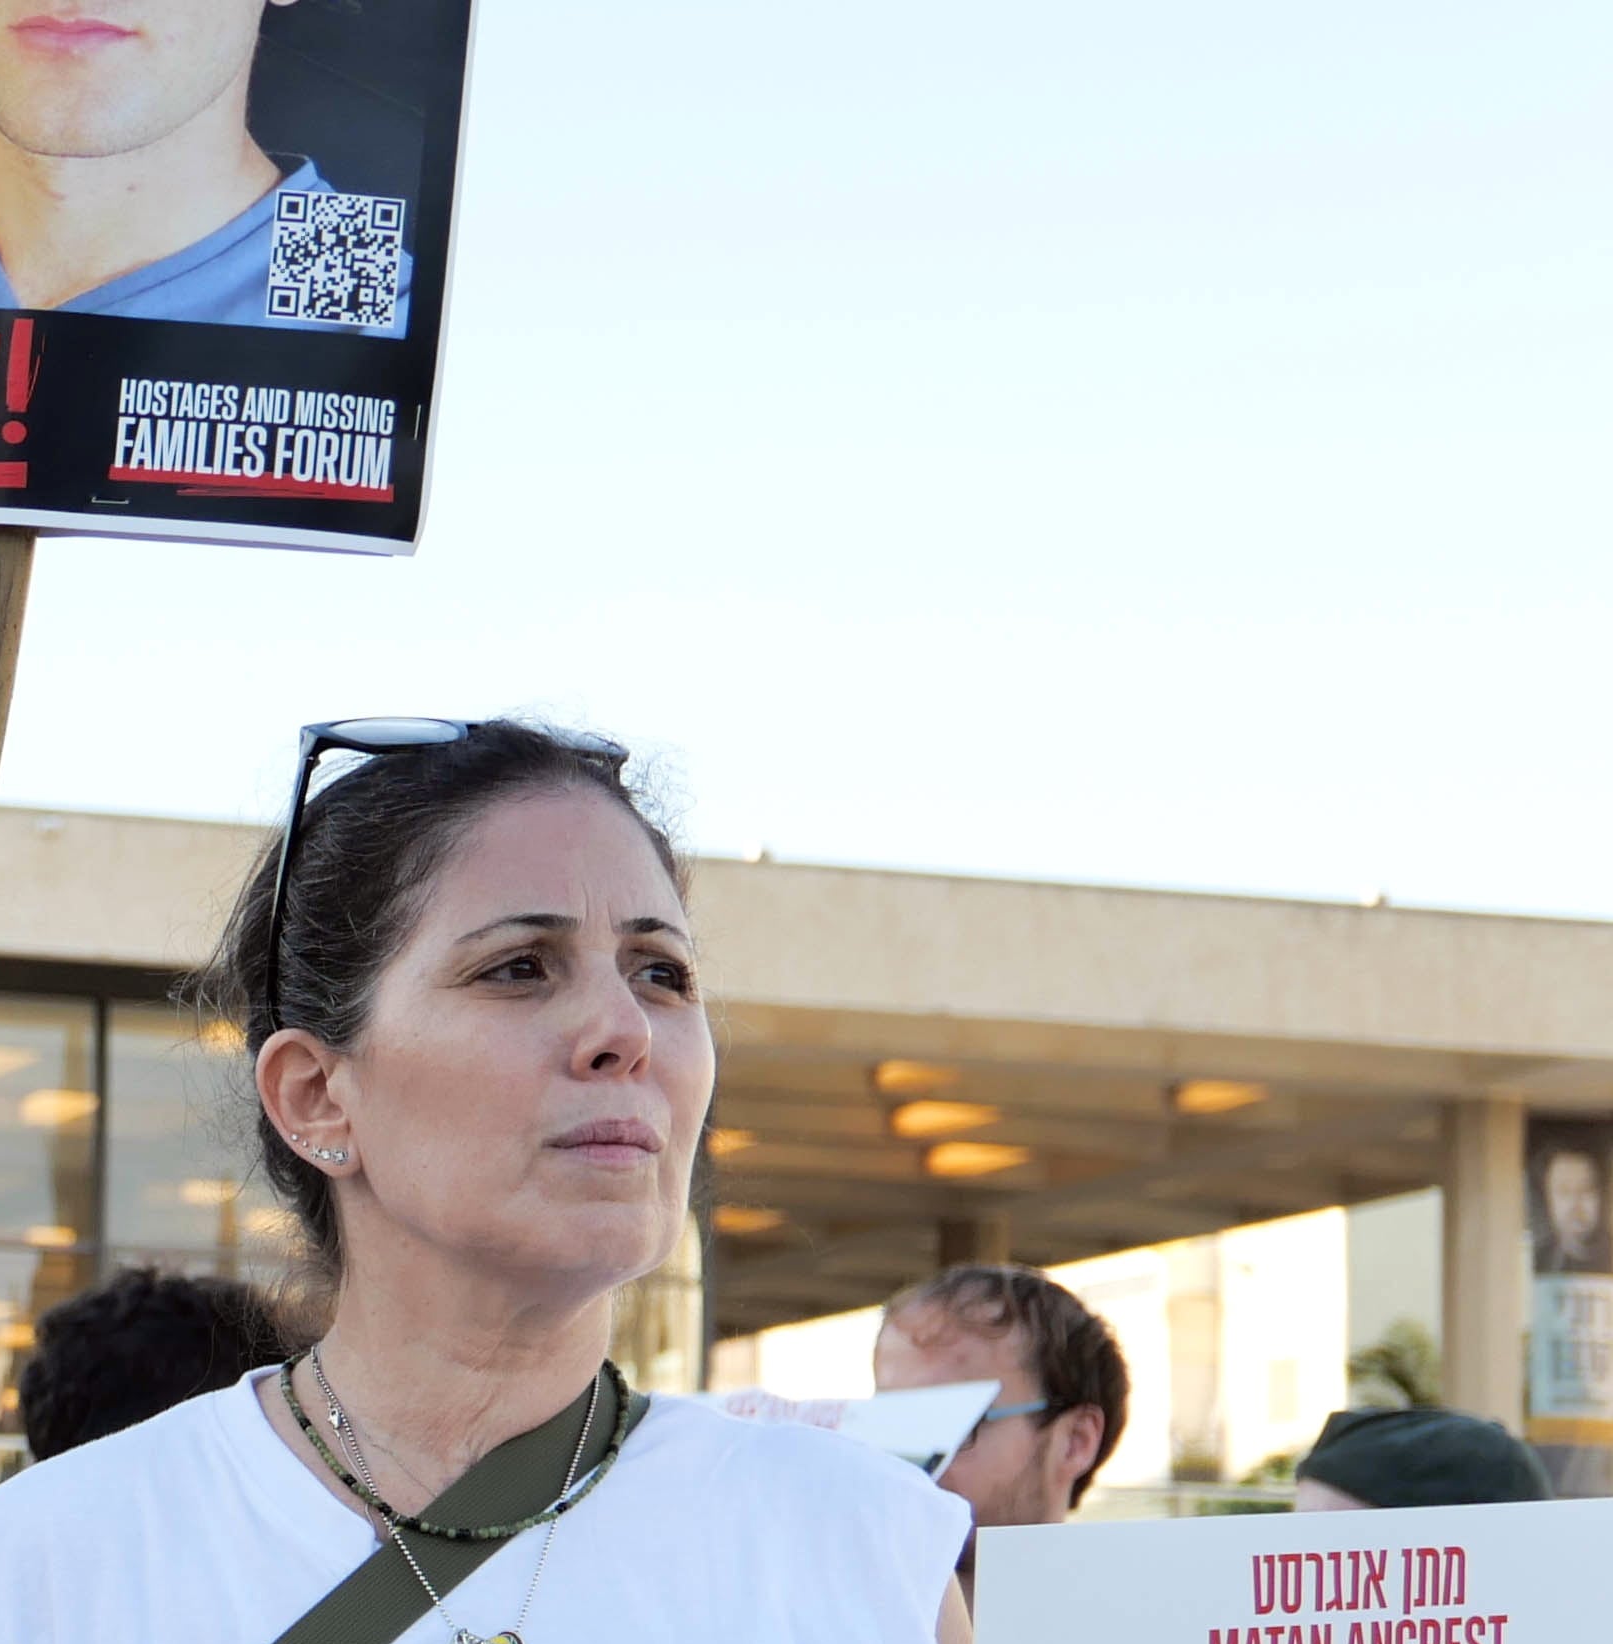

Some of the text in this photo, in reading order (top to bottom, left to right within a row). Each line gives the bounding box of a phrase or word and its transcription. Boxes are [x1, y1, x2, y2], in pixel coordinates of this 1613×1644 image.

[120, 378, 395, 436] HOSTAGES AND MISSING
[114, 417, 392, 490] FAMILIES FORUM
[1252, 1547, 1466, 1614] מתן אנגרסט
